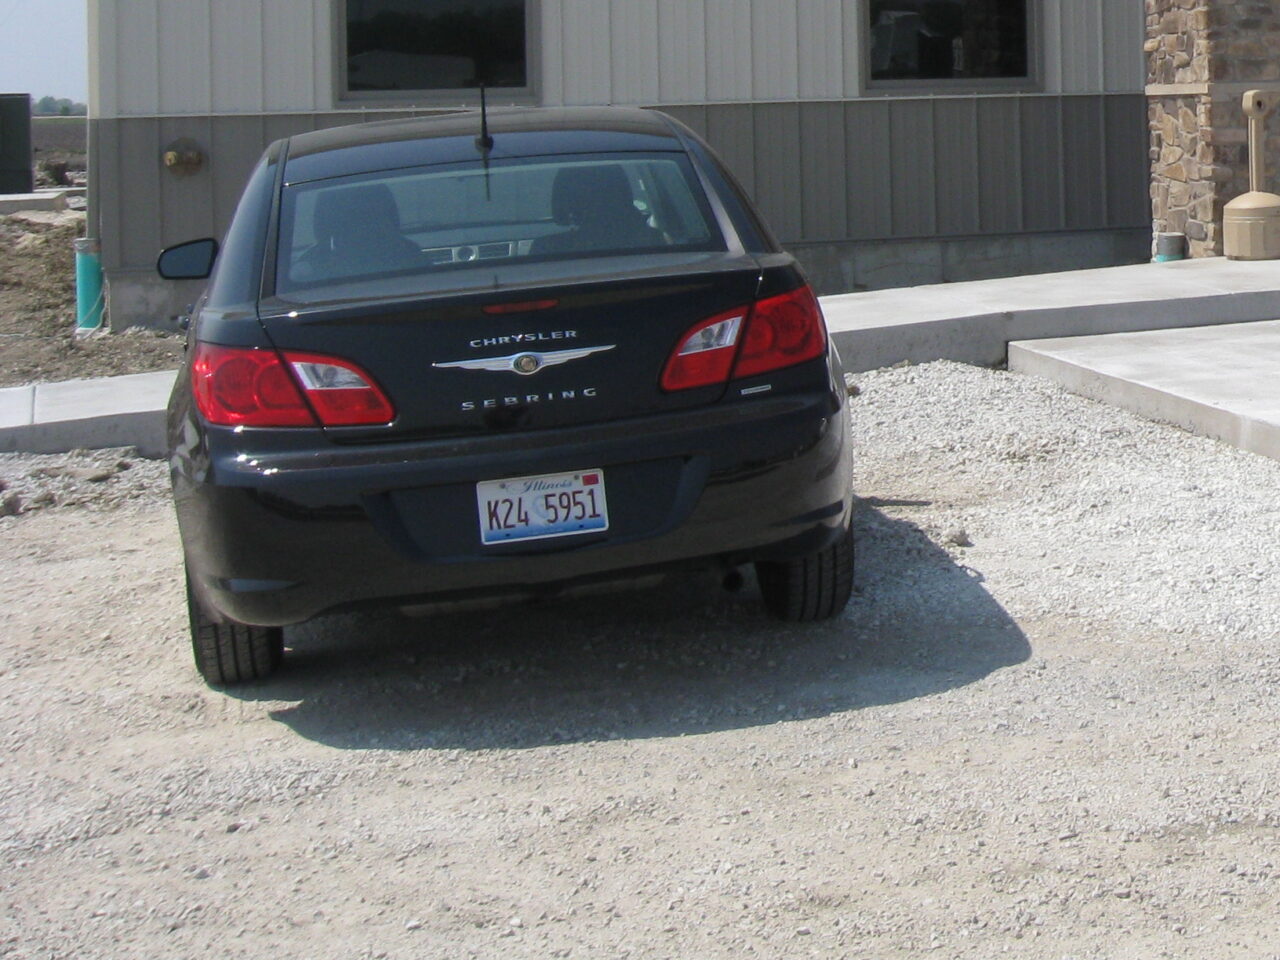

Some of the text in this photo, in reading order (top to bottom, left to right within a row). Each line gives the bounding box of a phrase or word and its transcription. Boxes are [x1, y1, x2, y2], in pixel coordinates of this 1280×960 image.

[470, 330, 577, 348] CHRYSLER
[462, 388, 597, 411] SEBRING
[520, 479, 573, 494] Illinois
[487, 488, 601, 531] K24 5951
